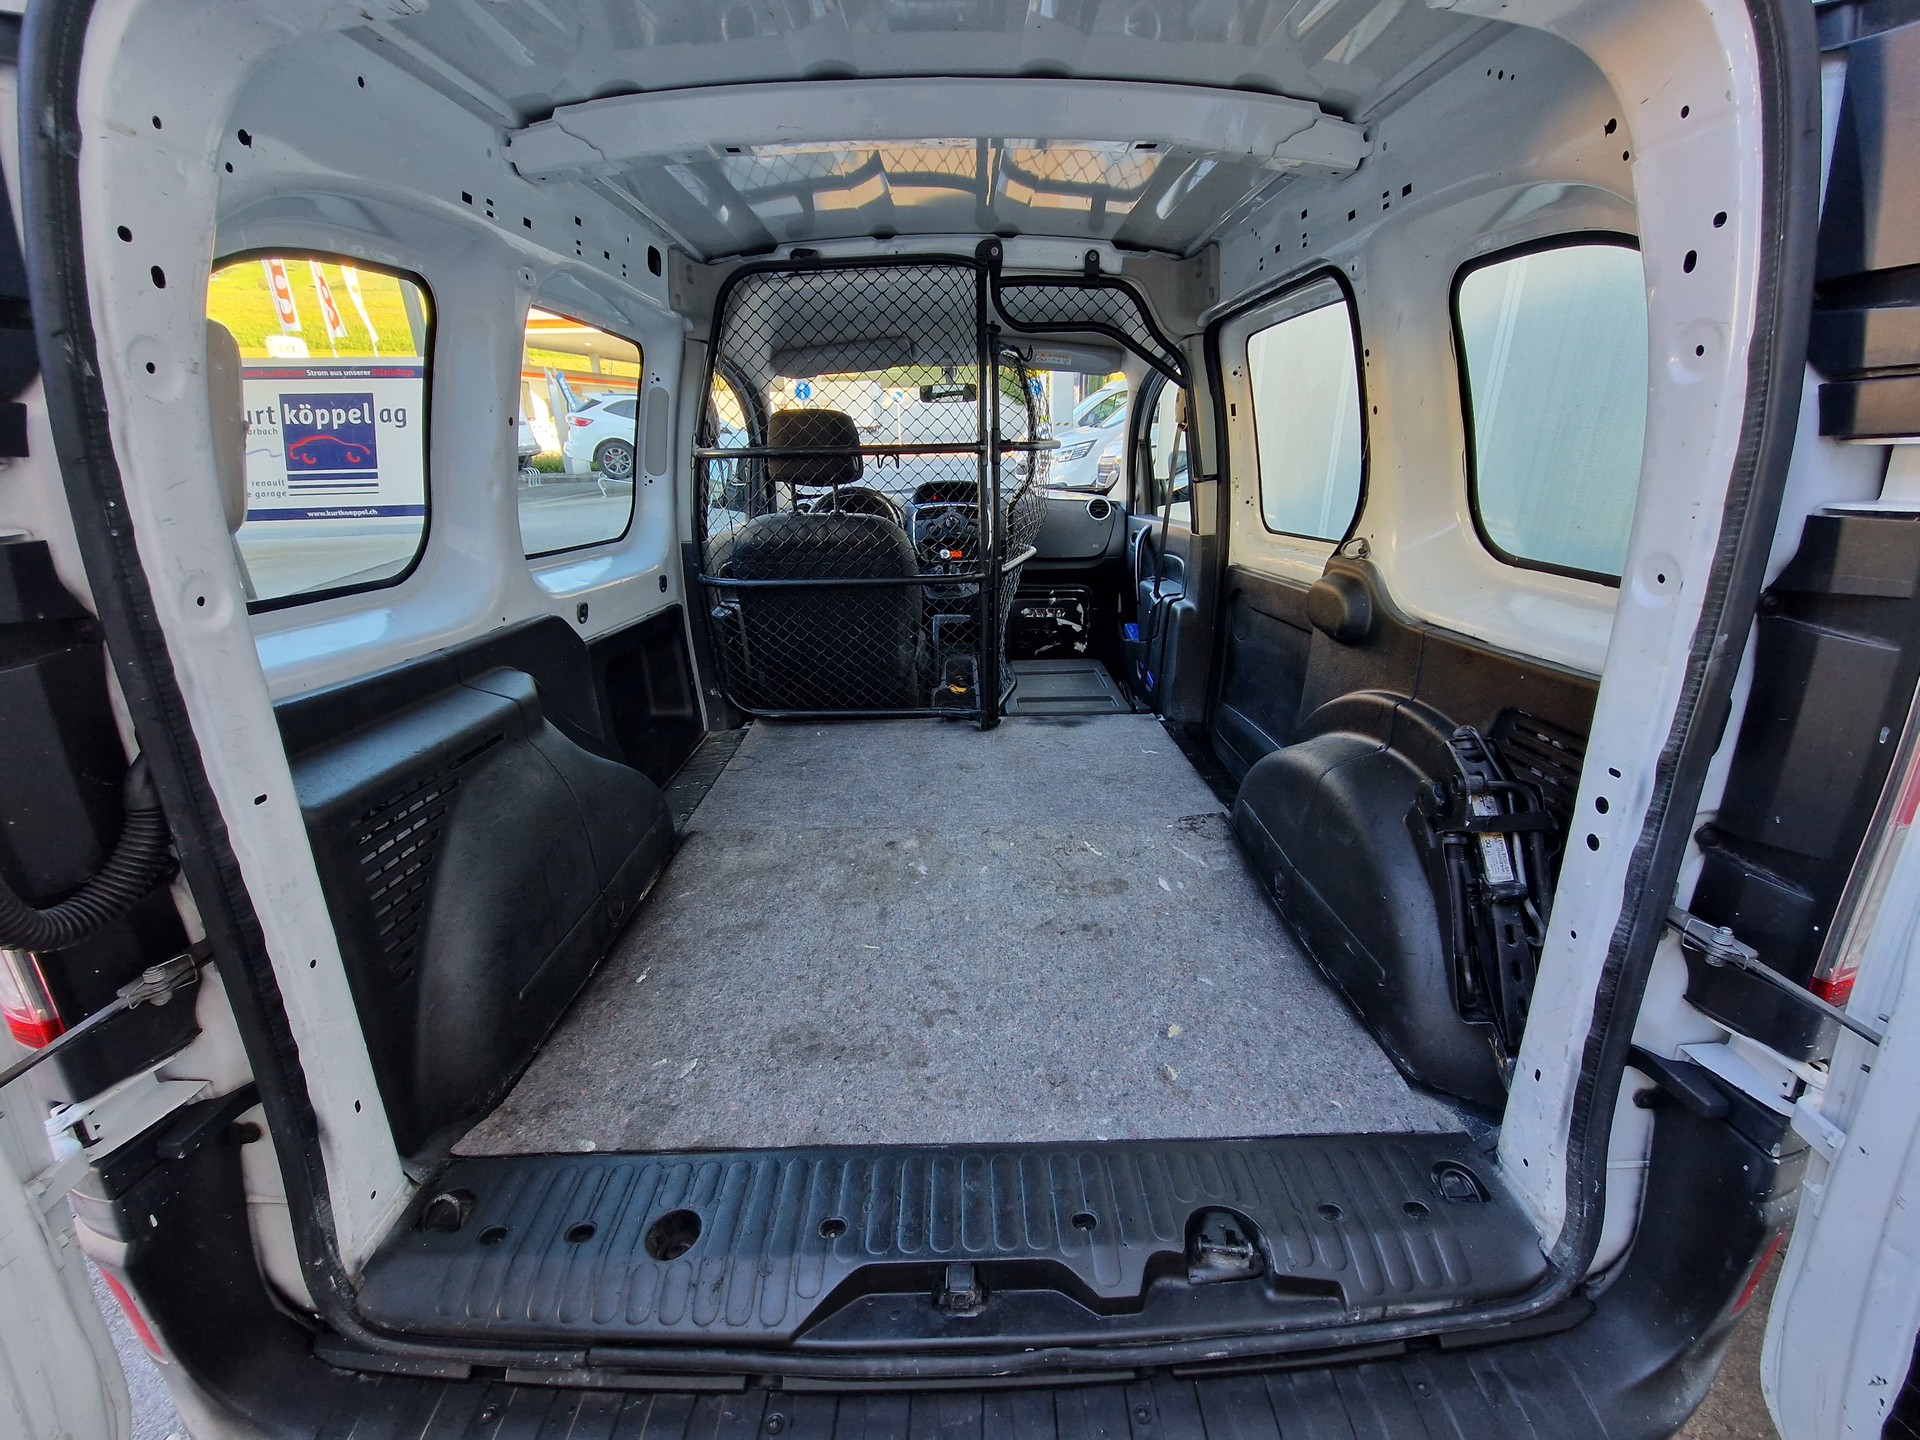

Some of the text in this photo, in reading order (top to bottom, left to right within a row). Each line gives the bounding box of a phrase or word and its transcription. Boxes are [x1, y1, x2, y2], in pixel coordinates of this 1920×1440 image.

[306, 369, 329, 377] Strom
[283, 402, 372, 430] köppel
[379, 407, 406, 428] ag
[247, 427, 278, 435] arbach
[255, 491, 287, 499] garage
[306, 508, 378, 517] www.kurtkoeppel.ch
